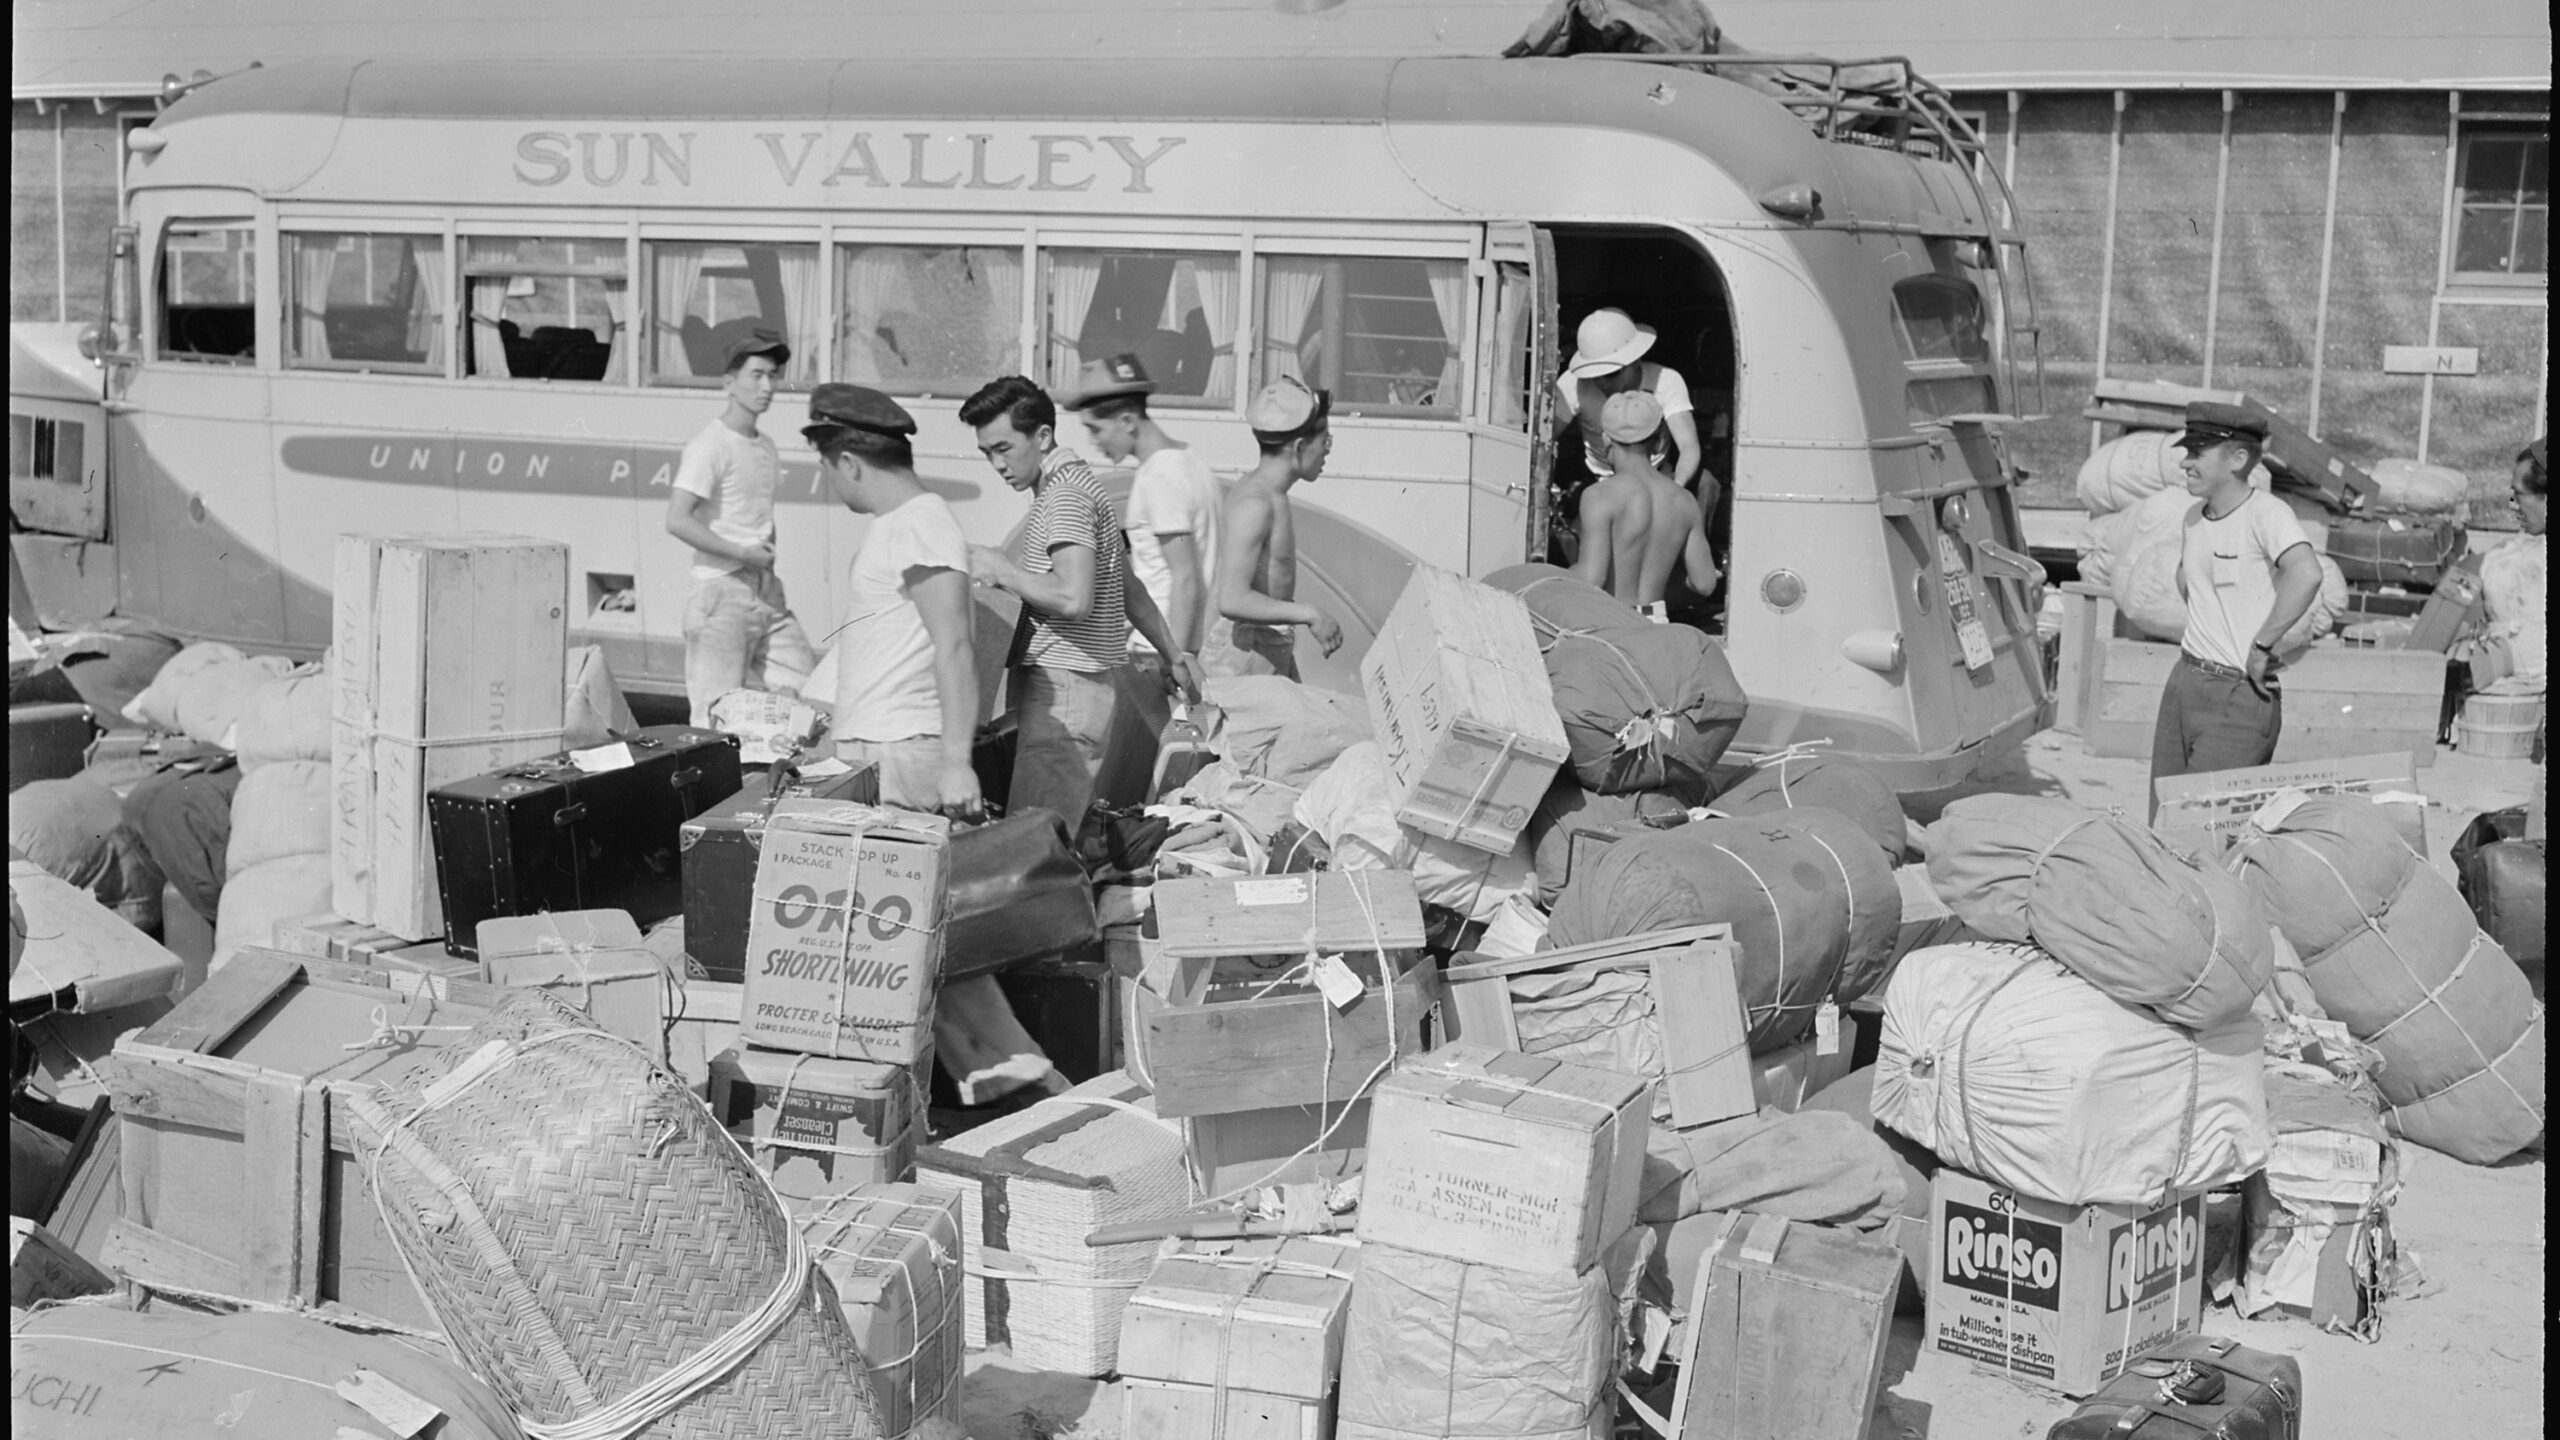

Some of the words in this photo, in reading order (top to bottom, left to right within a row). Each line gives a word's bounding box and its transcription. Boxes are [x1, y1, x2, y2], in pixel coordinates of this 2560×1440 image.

[512, 131, 697, 187] SUN
[754, 132, 1187, 193] VALLEY
[368, 445, 549, 479] UNION
[781, 854, 833, 869] PACKAGE
[801, 843, 844, 858] STACK
[850, 848, 877, 863] OP
[882, 852, 899, 864] UP
[906, 871, 922, 881] 48
[773, 884, 912, 942] ORO
[757, 1003, 818, 1024] PROCTER
[826, 1101, 854, 1113] SWIFT
[783, 1115, 833, 1136] Cleanser
[1948, 1216, 2058, 1290] Rinso
[2110, 1215, 2197, 1309] Rinso
[1970, 1294, 1993, 1307] MADE
[1996, 1299, 2005, 1308] IN
[1940, 1323, 1951, 1337] in
[2012, 1341, 2055, 1365] dishpan
[1960, 1314, 2004, 1338] Millions
[2006, 1329, 2025, 1344] se
[2027, 1332, 2038, 1347] it
